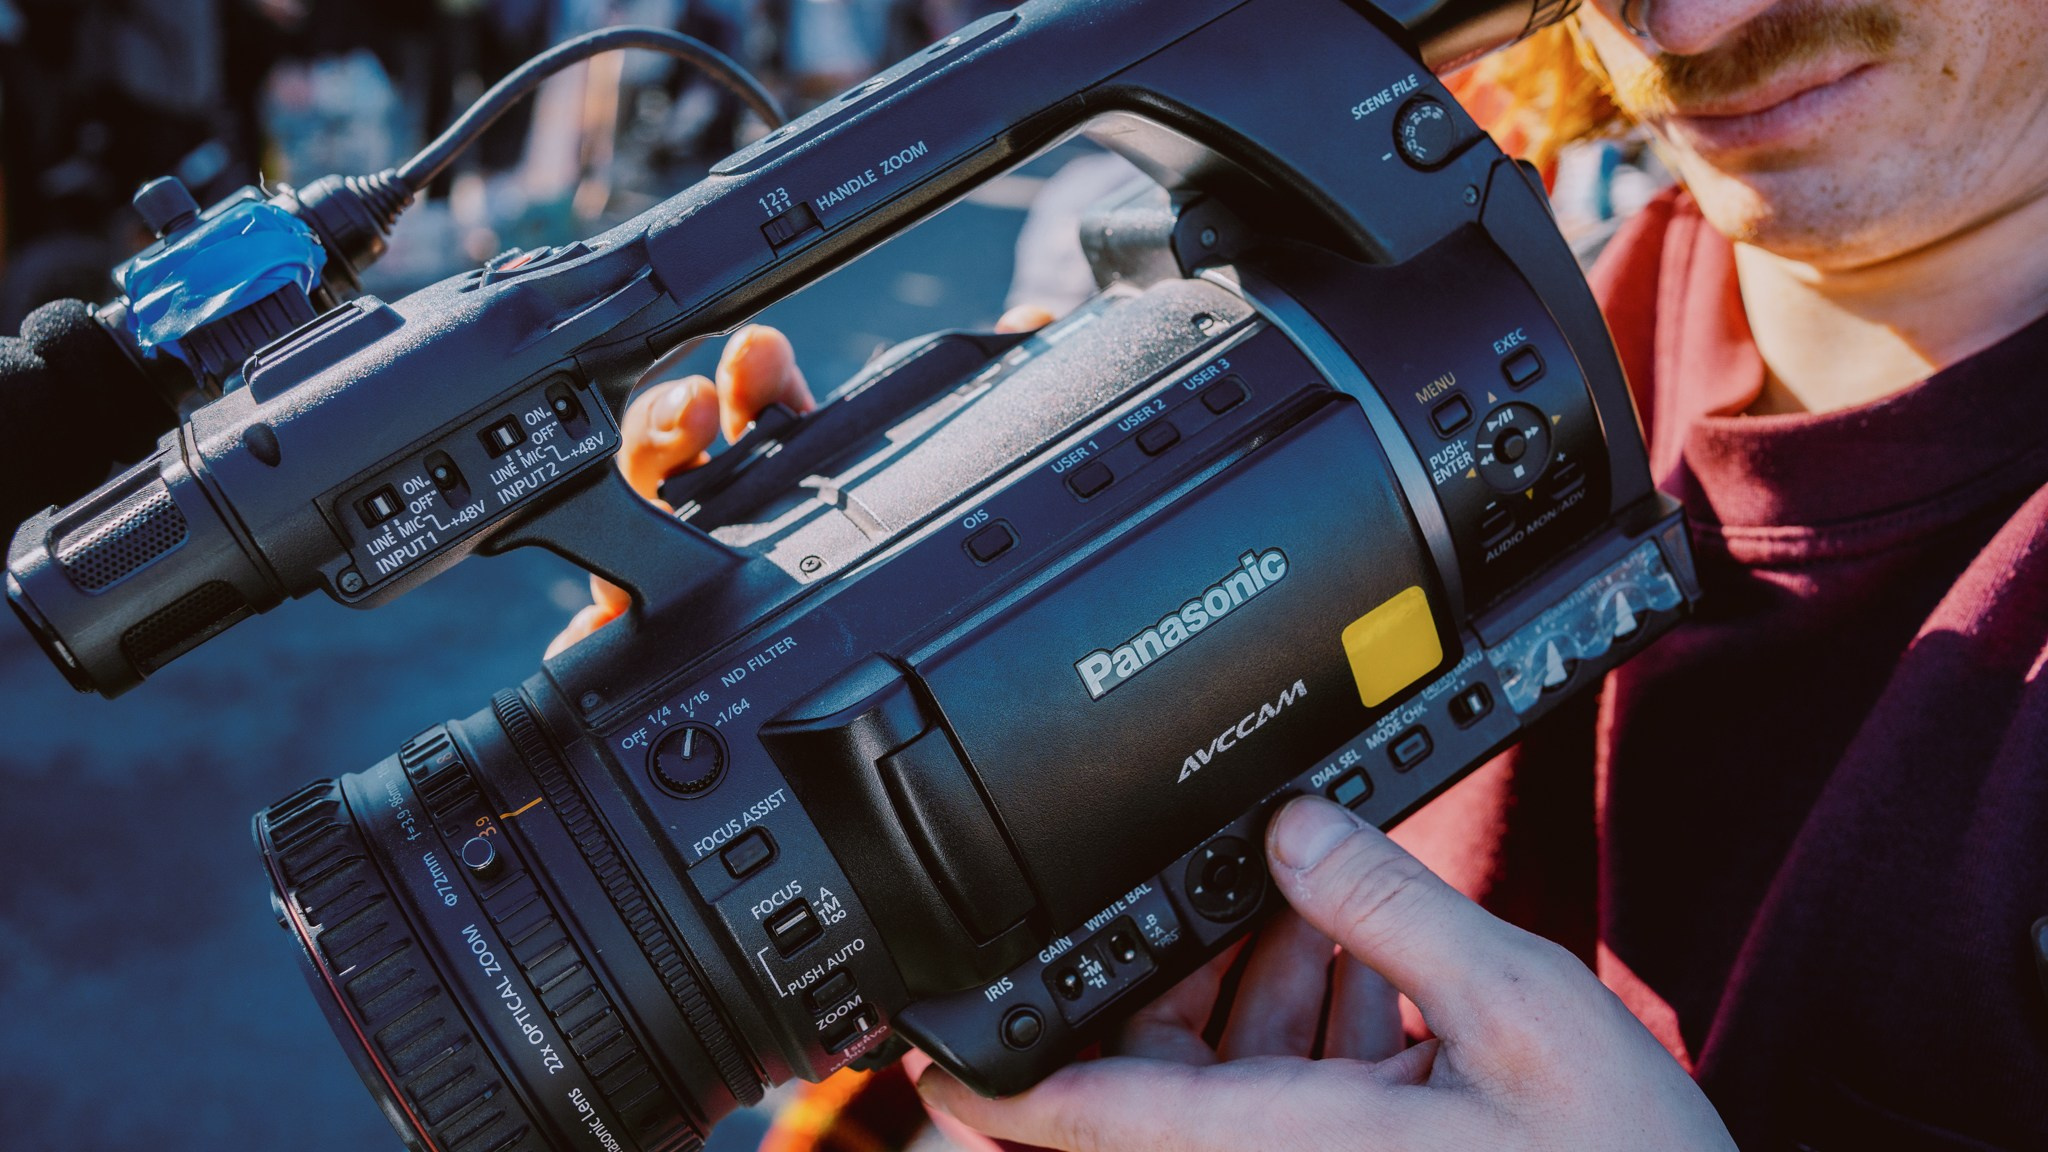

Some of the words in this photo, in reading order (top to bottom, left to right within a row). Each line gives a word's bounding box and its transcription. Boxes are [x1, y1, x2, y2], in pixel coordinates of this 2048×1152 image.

[1351, 89, 1392, 120] SCENE
[1392, 74, 1419, 97] FILE
[816, 170, 878, 211] HANDLE
[879, 141, 928, 175] ZOOM
[1493, 327, 1528, 354] EXEC
[1182, 364, 1220, 391] USER
[1218, 358, 1230, 369] 3
[1415, 372, 1457, 404] MENU
[525, 407, 546, 426] ON
[1117, 405, 1155, 432] USER
[1153, 399, 1166, 410] 2
[531, 424, 555, 445] OFF
[570, 432, 604, 458] +48V
[490, 462, 519, 485] LINE
[520, 447, 546, 469] MIC
[1051, 447, 1090, 474] USER
[1089, 441, 1099, 450] 1
[1430, 440, 1468, 470] PUSH-
[1434, 451, 1474, 485] ENTER
[403, 476, 425, 495] ON
[410, 494, 434, 515] OFF
[450, 500, 486, 527] +48V
[963, 509, 989, 530] OIS
[366, 534, 397, 556] LINE
[397, 517, 425, 538] MIC
[1485, 530, 1524, 563] AUDIO
[1527, 488, 1586, 534] MON/ADV
[1078, 549, 1287, 698] Panasonic
[721, 667, 746, 687] ND
[747, 636, 797, 671] FILTER
[648, 706, 671, 724] 1/4
[680, 690, 710, 713] 1/16
[718, 698, 750, 723] 1/64
[621, 728, 648, 749] OFF
[1177, 679, 1308, 784] AVCCAM
[1366, 719, 1401, 750] MODE
[1403, 702, 1428, 725] CHK
[1311, 764, 1341, 788] DIAL
[1339, 749, 1361, 769] SEL
[475, 816, 497, 838] 3.9
[693, 819, 742, 857] FOCUS
[743, 789, 787, 827] ASSIST
[751, 880, 802, 920] FOCUS
[819, 887, 833, 901] A
[824, 896, 841, 914] M
[1084, 900, 1126, 931] WHITE
[1125, 883, 1152, 905] BAL
[1146, 914, 1157, 926] B
[1154, 927, 1166, 937] A
[462, 924, 501, 977] ZOOM
[1038, 936, 1073, 963] GAIN
[1081, 955, 1091, 965] L
[787, 965, 825, 995] PUSH
[827, 939, 864, 970] AUTO
[1088, 961, 1103, 978] M
[1094, 974, 1107, 989] H
[984, 977, 1014, 1002] IRIS
[496, 975, 544, 1045] OPTICAL
[816, 995, 862, 1030] ZOOM
[851, 1025, 887, 1051] SERVO
[540, 1044, 564, 1075] 22x
[568, 1087, 595, 1121] Lens
